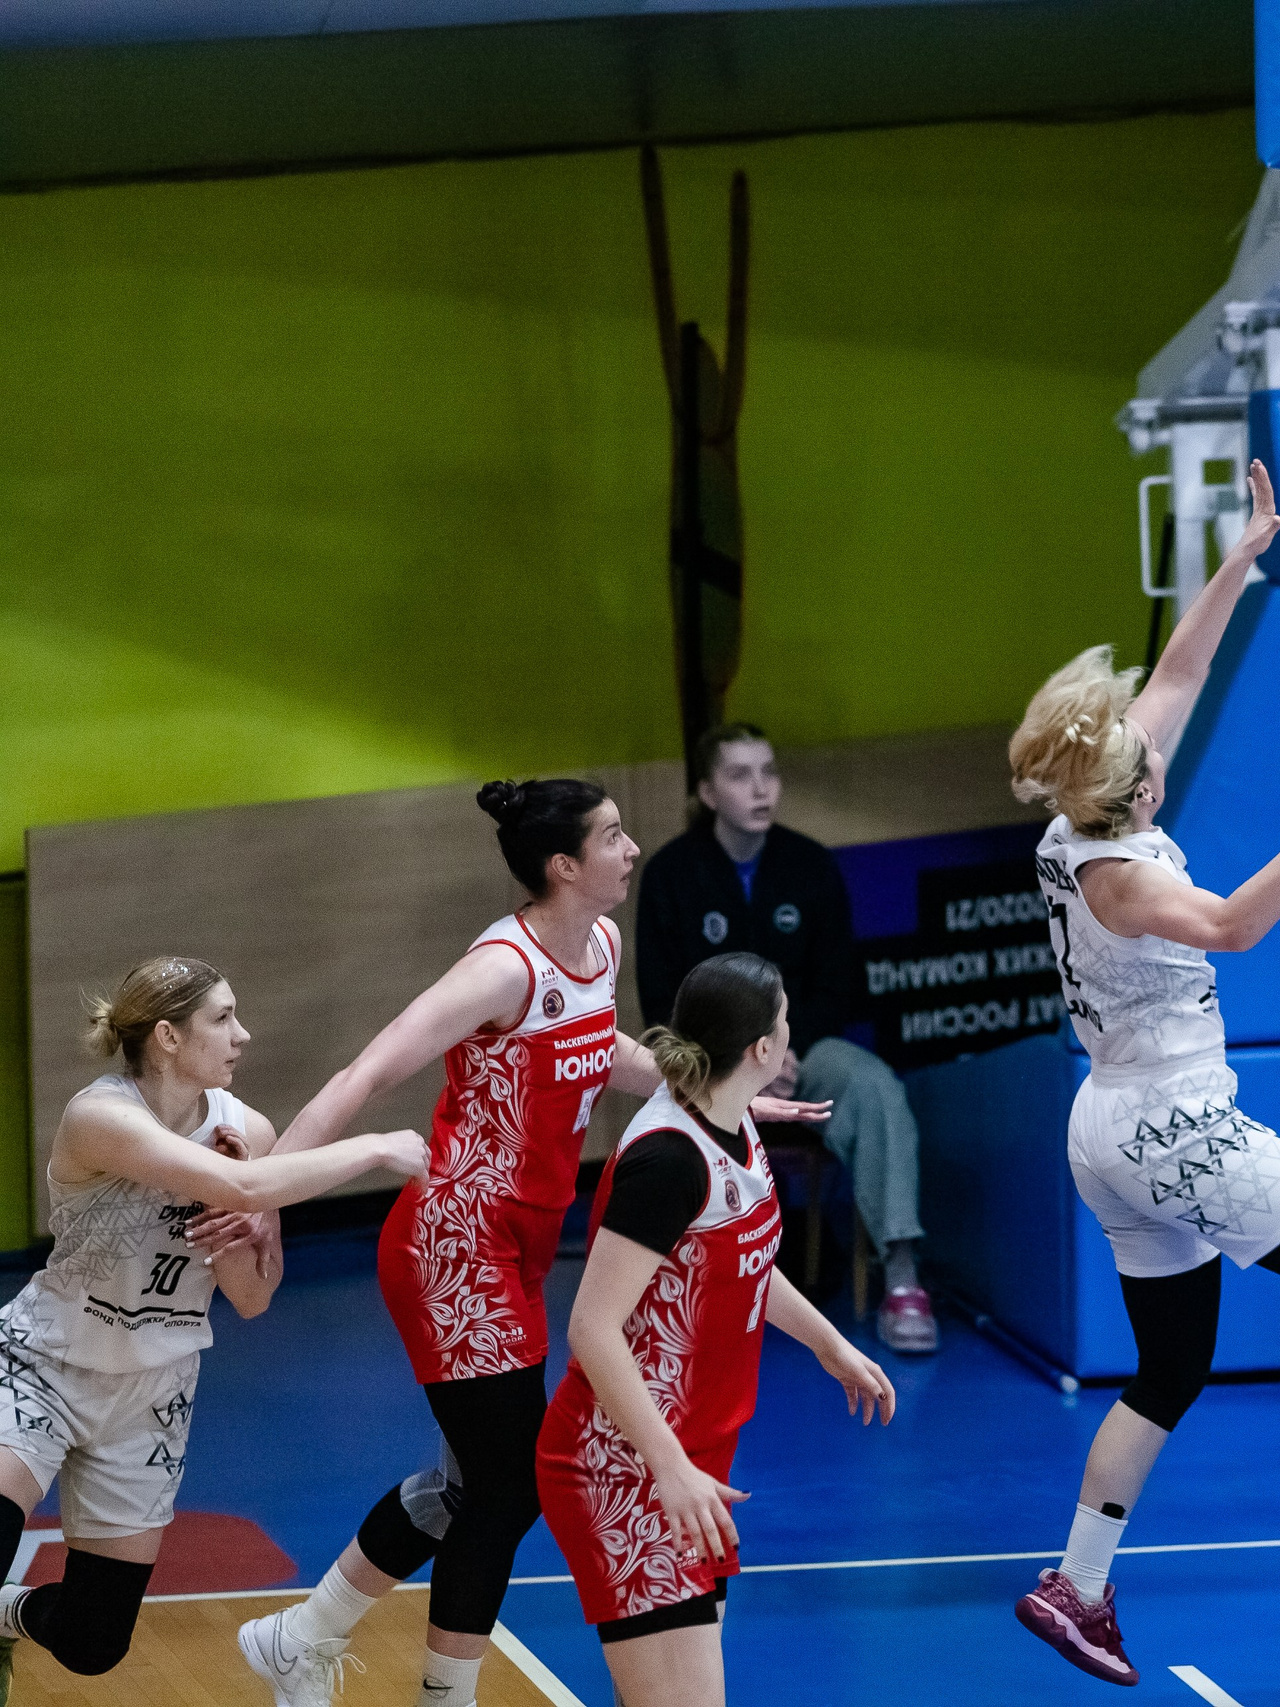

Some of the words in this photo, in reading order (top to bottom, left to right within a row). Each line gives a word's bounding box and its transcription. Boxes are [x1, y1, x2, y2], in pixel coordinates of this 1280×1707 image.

[866, 951, 989, 995] КОМАНД
[554, 1025, 614, 1050] БАСКЕТБОЛЬНЫЙ
[901, 998, 1021, 1043] РОССИИ
[141, 1252, 191, 1296] 30
[83, 1306, 116, 1327] ФОНД
